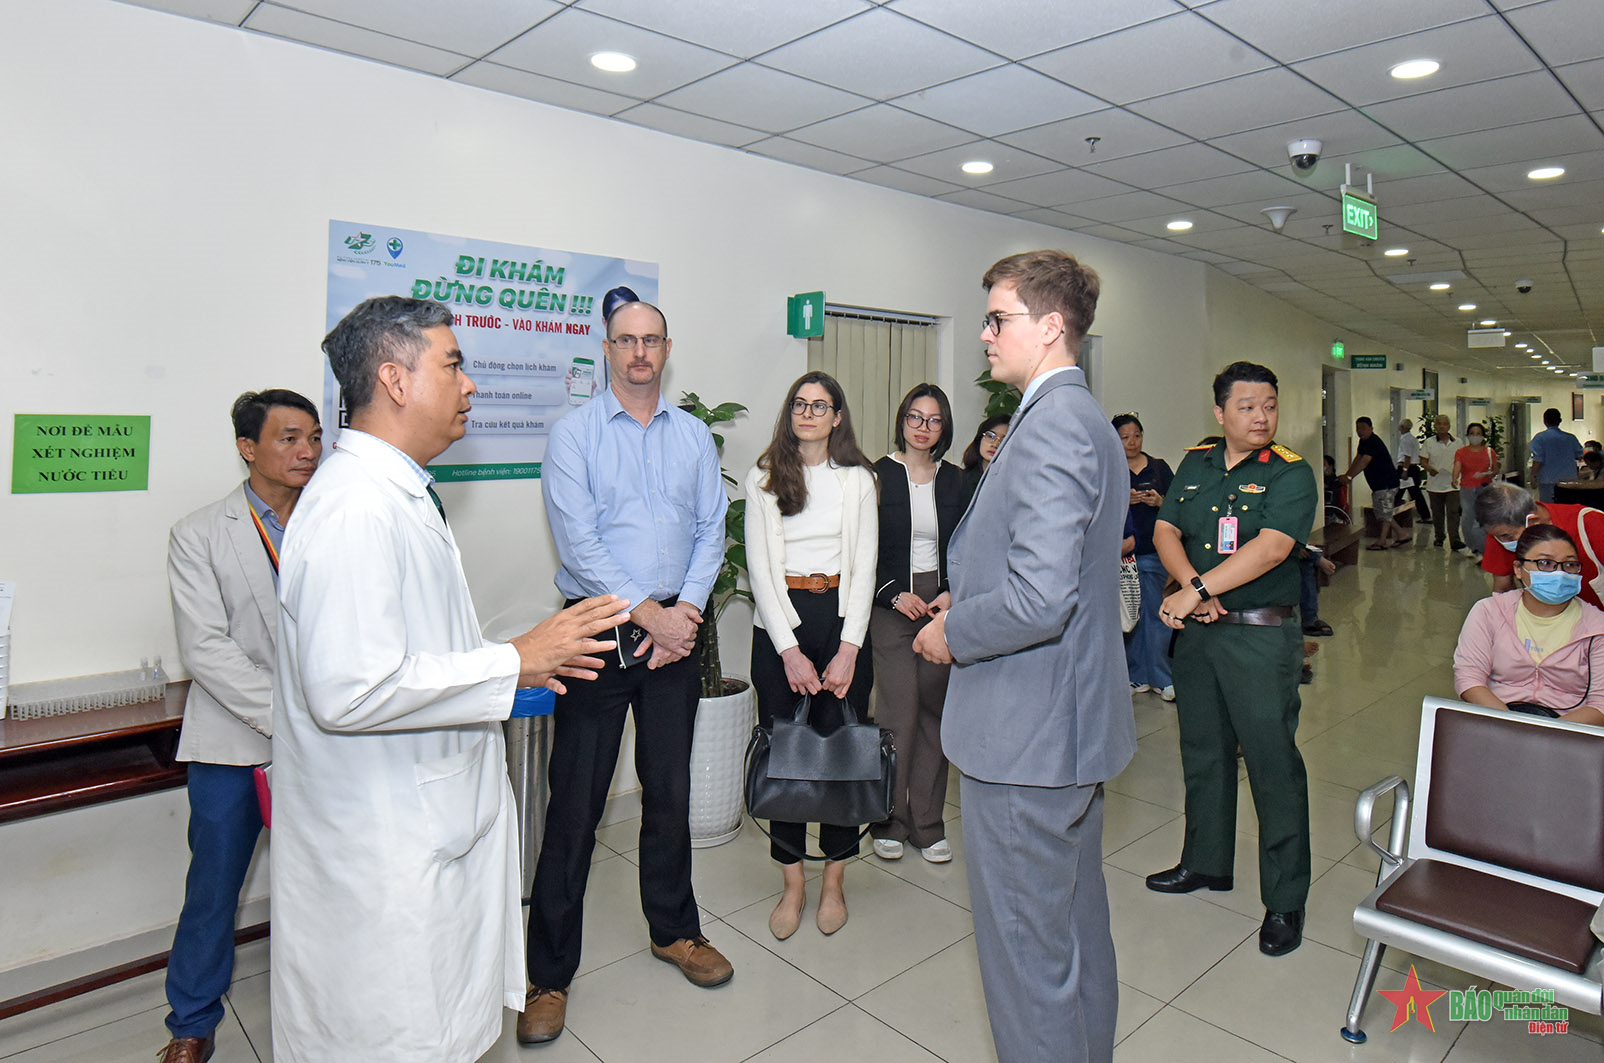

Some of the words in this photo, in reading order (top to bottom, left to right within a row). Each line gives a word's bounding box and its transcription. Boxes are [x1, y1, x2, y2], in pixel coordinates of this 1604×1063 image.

[1347, 203, 1370, 230] EXIT
[455, 254, 485, 277] ĐI
[489, 259, 566, 286] KHÁM
[411, 276, 494, 306] ĐỪNG
[499, 287, 567, 312] QUÊN
[570, 295, 594, 315] !!!
[465, 314, 502, 329] TRƯỚC
[512, 318, 533, 332] VÀO
[535, 320, 563, 334] KHÁM
[565, 322, 591, 336] NGAY
[472, 391, 493, 399] Thanh
[512, 392, 532, 400] online
[36, 425, 66, 437] NƠI
[471, 420, 483, 429] Tra
[32, 445, 66, 458] XÉT
[70, 448, 136, 460] NGHIỆM
[38, 469, 88, 482] NƯỚC
[452, 469, 477, 477] Hotline
